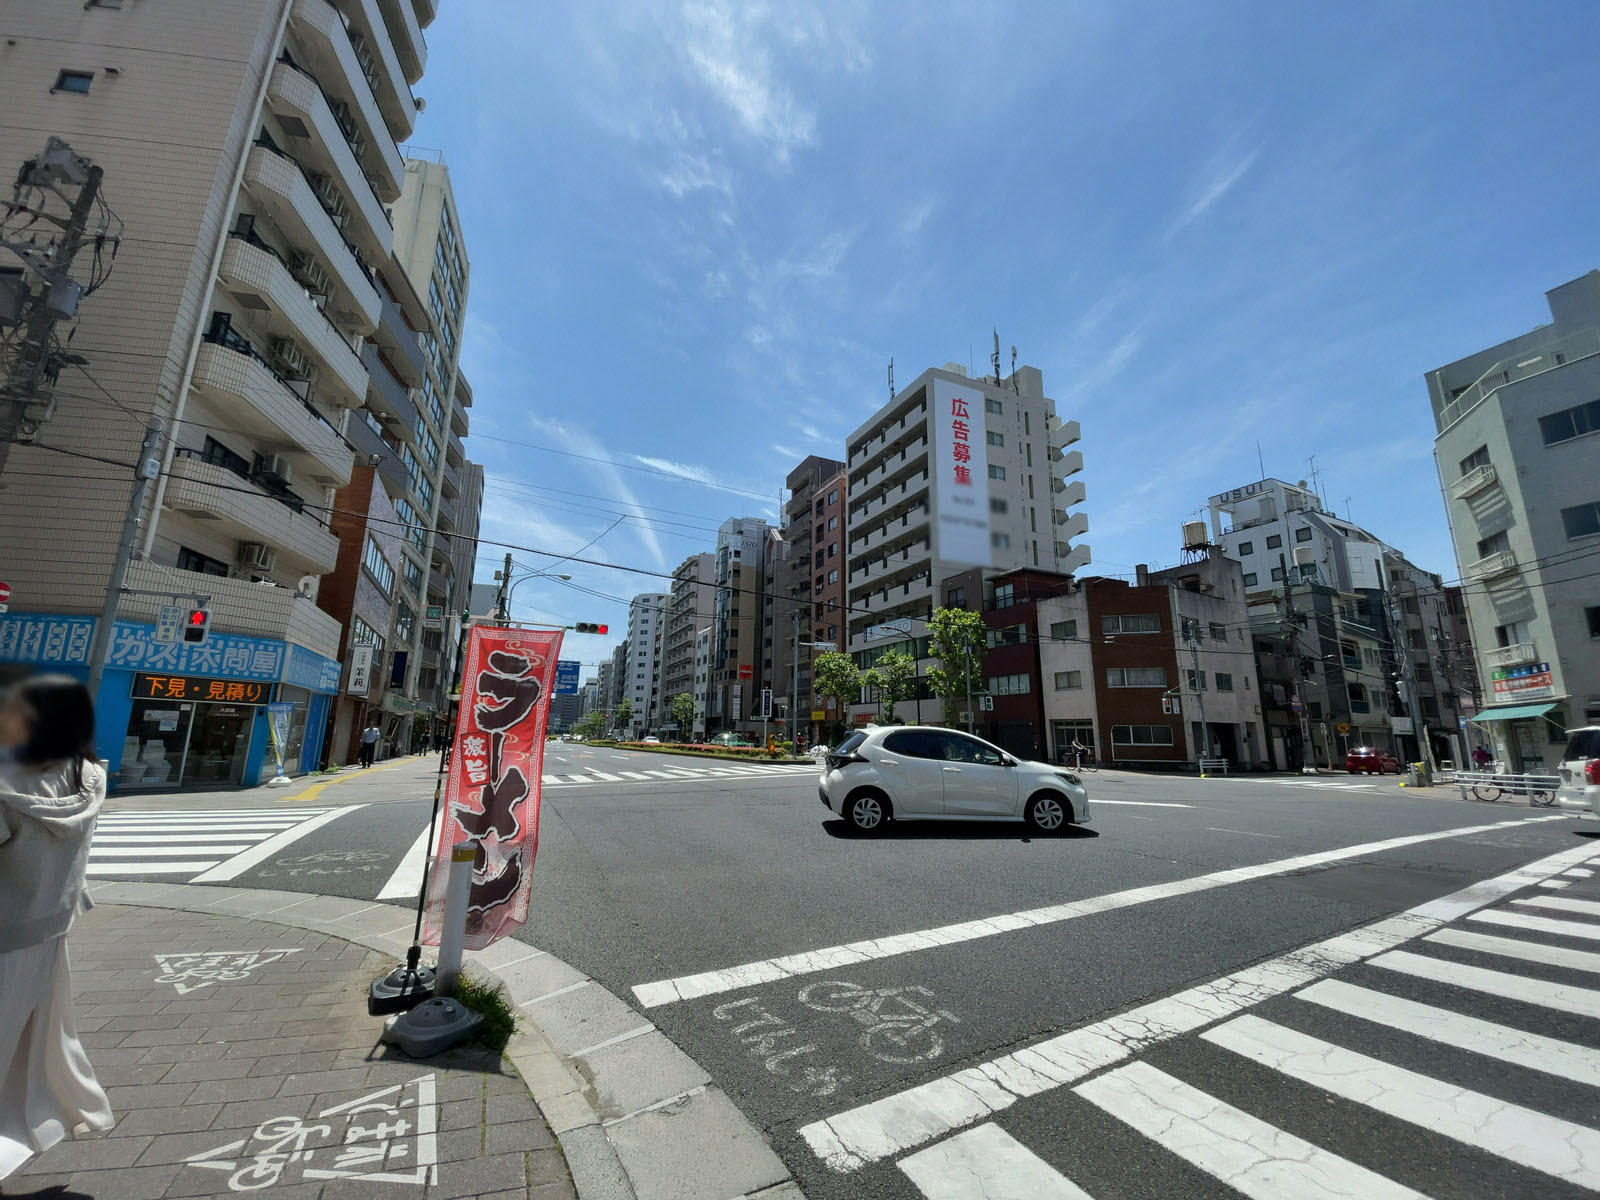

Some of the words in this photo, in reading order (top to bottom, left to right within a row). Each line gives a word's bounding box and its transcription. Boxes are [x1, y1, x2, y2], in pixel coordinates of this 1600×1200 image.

[951, 397, 972, 487] 広告募集
[1220, 482, 1264, 503] USUI
[145, 676, 263, 702] 下見・見積り
[450, 651, 542, 912] ラーメン
[463, 736, 488, 783] 激旨
